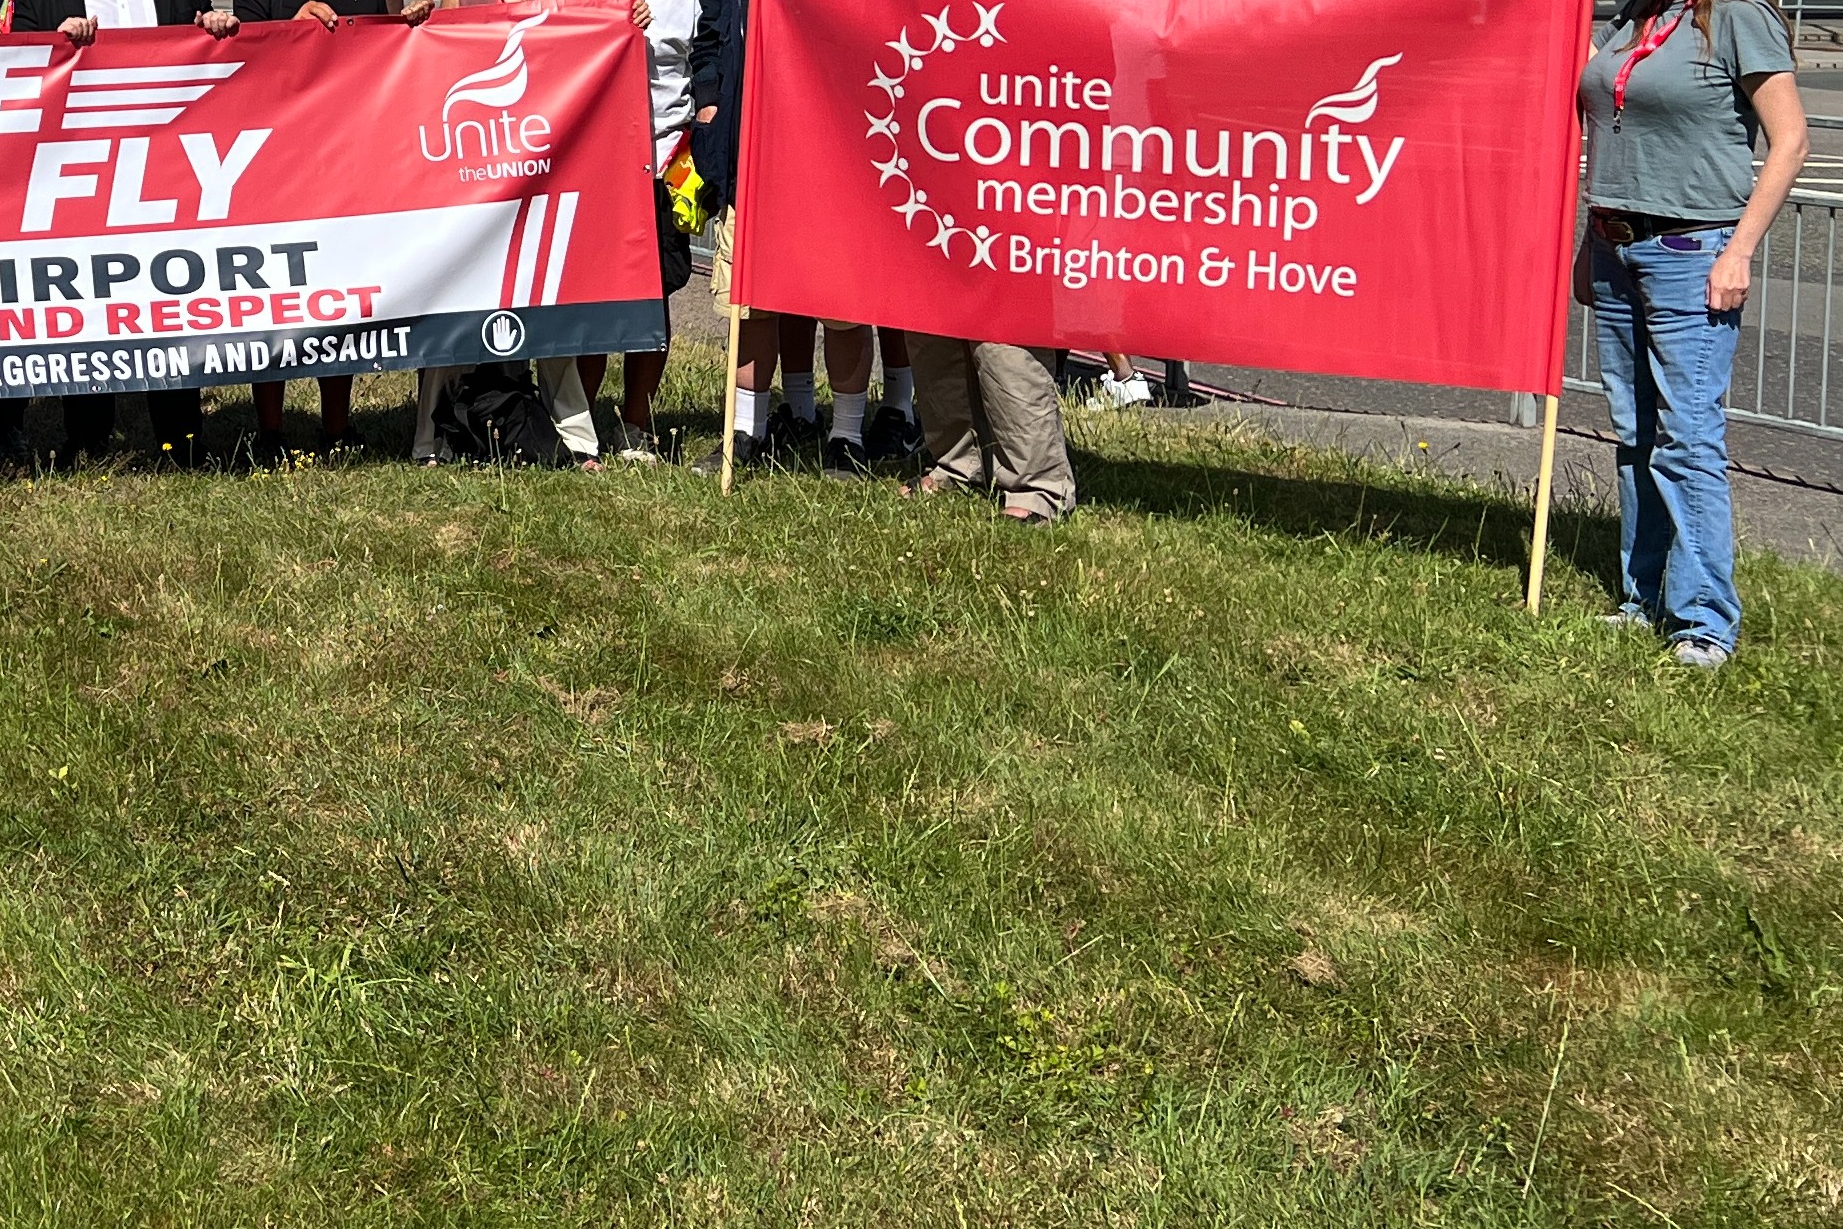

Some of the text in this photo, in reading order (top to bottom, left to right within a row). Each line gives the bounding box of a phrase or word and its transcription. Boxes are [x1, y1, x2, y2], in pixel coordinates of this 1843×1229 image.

[979, 66, 1112, 111] unite
[419, 110, 551, 162] unite
[916, 97, 1405, 205] Community
[20, 128, 273, 232] FLY
[975, 174, 1318, 241] membership
[1008, 233, 1358, 297] Brighton & Hove
[106, 286, 381, 335] RESPECT
[203, 340, 270, 374] AND
[279, 326, 411, 368] ASSAULT
